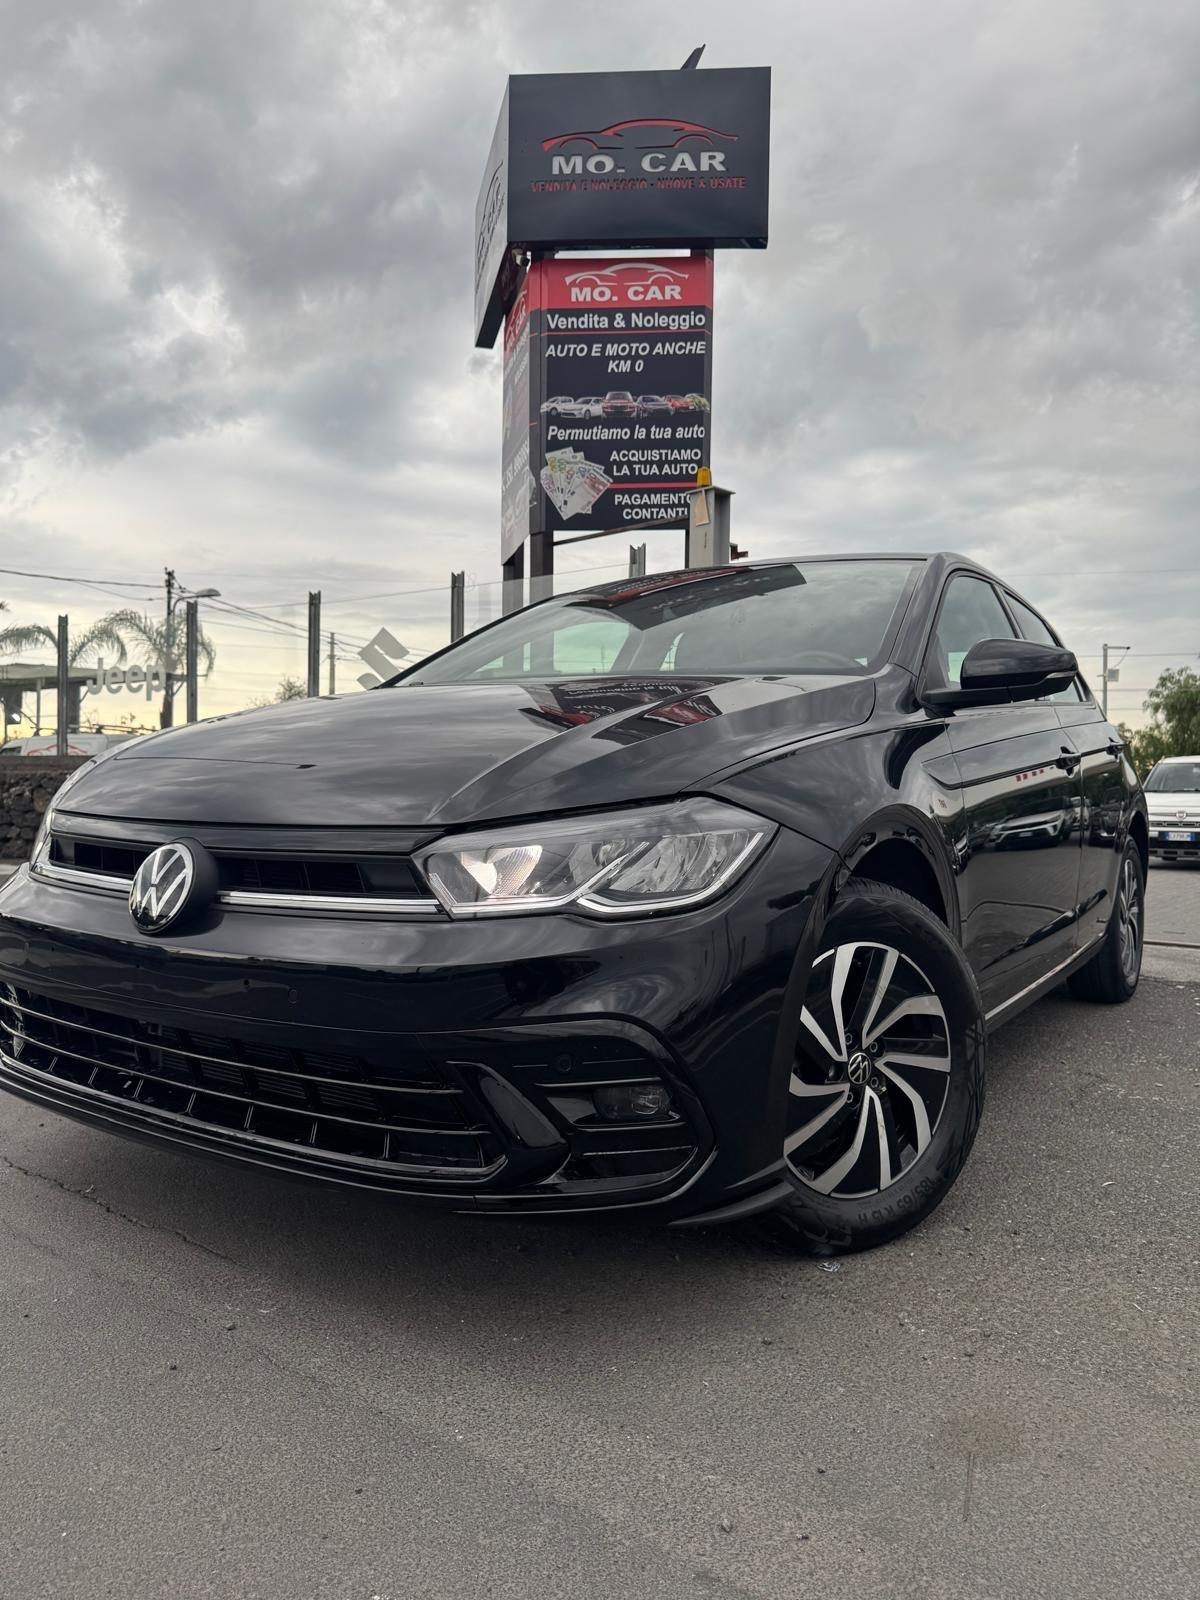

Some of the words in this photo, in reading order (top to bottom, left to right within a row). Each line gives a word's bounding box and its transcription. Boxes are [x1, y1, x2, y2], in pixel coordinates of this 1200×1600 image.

[552, 154, 625, 175] MO.
[641, 151, 727, 173] CAR
[531, 179, 577, 192] VENDITA
[581, 179, 588, 191] E
[591, 177, 648, 191] NOLEGGIO
[655, 176, 695, 190] NUOVE
[710, 175, 747, 189] USATE
[570, 287, 618, 302] MO.
[627, 285, 682, 301] CAR
[547, 313, 609, 329] Vendita
[613, 313, 626, 328] &
[631, 311, 706, 330] Noleggio
[545, 344, 588, 357] AUTO
[591, 343, 602, 356] E
[605, 342, 650, 356] MOTO
[652, 341, 706, 356] ANCHE
[608, 360, 631, 373] KM
[635, 360, 644, 372] 0
[547, 425, 631, 441] Permutiamo
[634, 425, 645, 440] la
[650, 426, 672, 439] tua
[676, 424, 706, 439] auto
[610, 448, 702, 463] ACQUISTIAMO
[613, 464, 631, 476] LA
[633, 464, 660, 476] TUA
[662, 463, 699, 475] AUTO
[86, 657, 167, 701] Jeep
